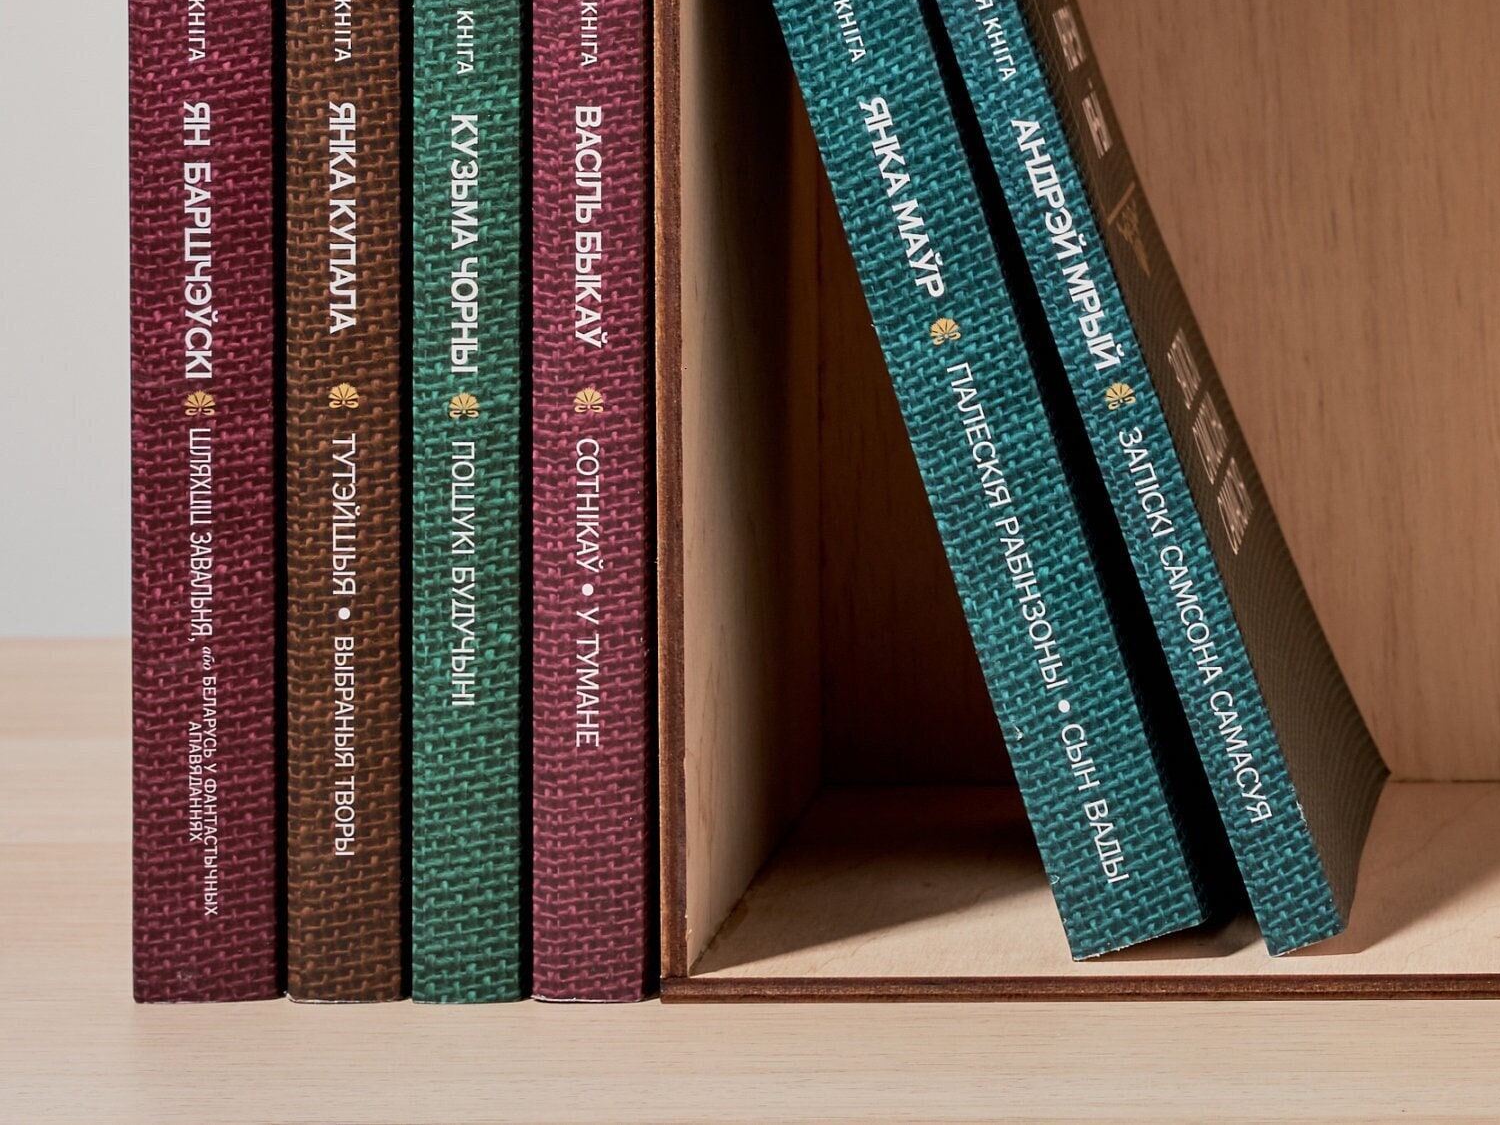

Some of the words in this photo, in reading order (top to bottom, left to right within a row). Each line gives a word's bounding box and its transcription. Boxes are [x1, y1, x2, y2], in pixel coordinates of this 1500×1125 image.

[456, 10, 474, 75] КНІГА
[580, 1, 598, 67] КНІГА
[982, 17, 1017, 82] КНІГА
[183, 101, 211, 146] ЯН
[328, 101, 357, 192] ЯНКА
[450, 114, 479, 250] КУЗЬМА
[574, 105, 603, 224] ВАСІЛЬ
[858, 96, 911, 198] ЯНКА
[891, 198, 945, 298] МАЎР
[1010, 119, 1087, 261] АНДРЭЙ
[1061, 261, 1125, 371] МРЫЙ
[183, 162, 219, 379] БАРШЧЭЎСКІ
[329, 199, 357, 334] КУПАЛА
[450, 256, 479, 374] ЧОРНЫ
[574, 231, 608, 349] БЫКАЎ
[189, 428, 213, 526] ШЛЯХЦІЦ
[331, 433, 361, 595] ТУТЭЙШЫЯ
[451, 441, 475, 555] ПОШУКІ
[575, 437, 604, 573] СОТНІКАЎ
[187, 531, 213, 642] ЗАВАЛЬНЯ,
[450, 567, 476, 706] БУДУЧЫНІ
[575, 606, 600, 625] У
[946, 362, 1012, 509] ПАЛЕСКІЯ
[994, 516, 1069, 690] РАБІНЗОНЫ
[1061, 723, 1101, 791] СЫН
[1083, 798, 1130, 884] ВАДЫ
[1118, 426, 1175, 538] ЗАПІСКІ
[1159, 545, 1223, 686] САМСОНА
[1209, 690, 1273, 823] САМАСУЯ
[202, 646, 215, 671] або
[202, 676, 217, 758] БЕЛАРУСЬ
[334, 636, 355, 767] ВЫБРАНЫЯ
[575, 633, 600, 748] ТУМАНЕ
[188, 721, 203, 842] АПАВЯДАННЯХ
[202, 763, 217, 773] У
[334, 775, 355, 856] ТВОРЫ
[203, 778, 218, 916] ФАНТАСТЫЧНЫХ
